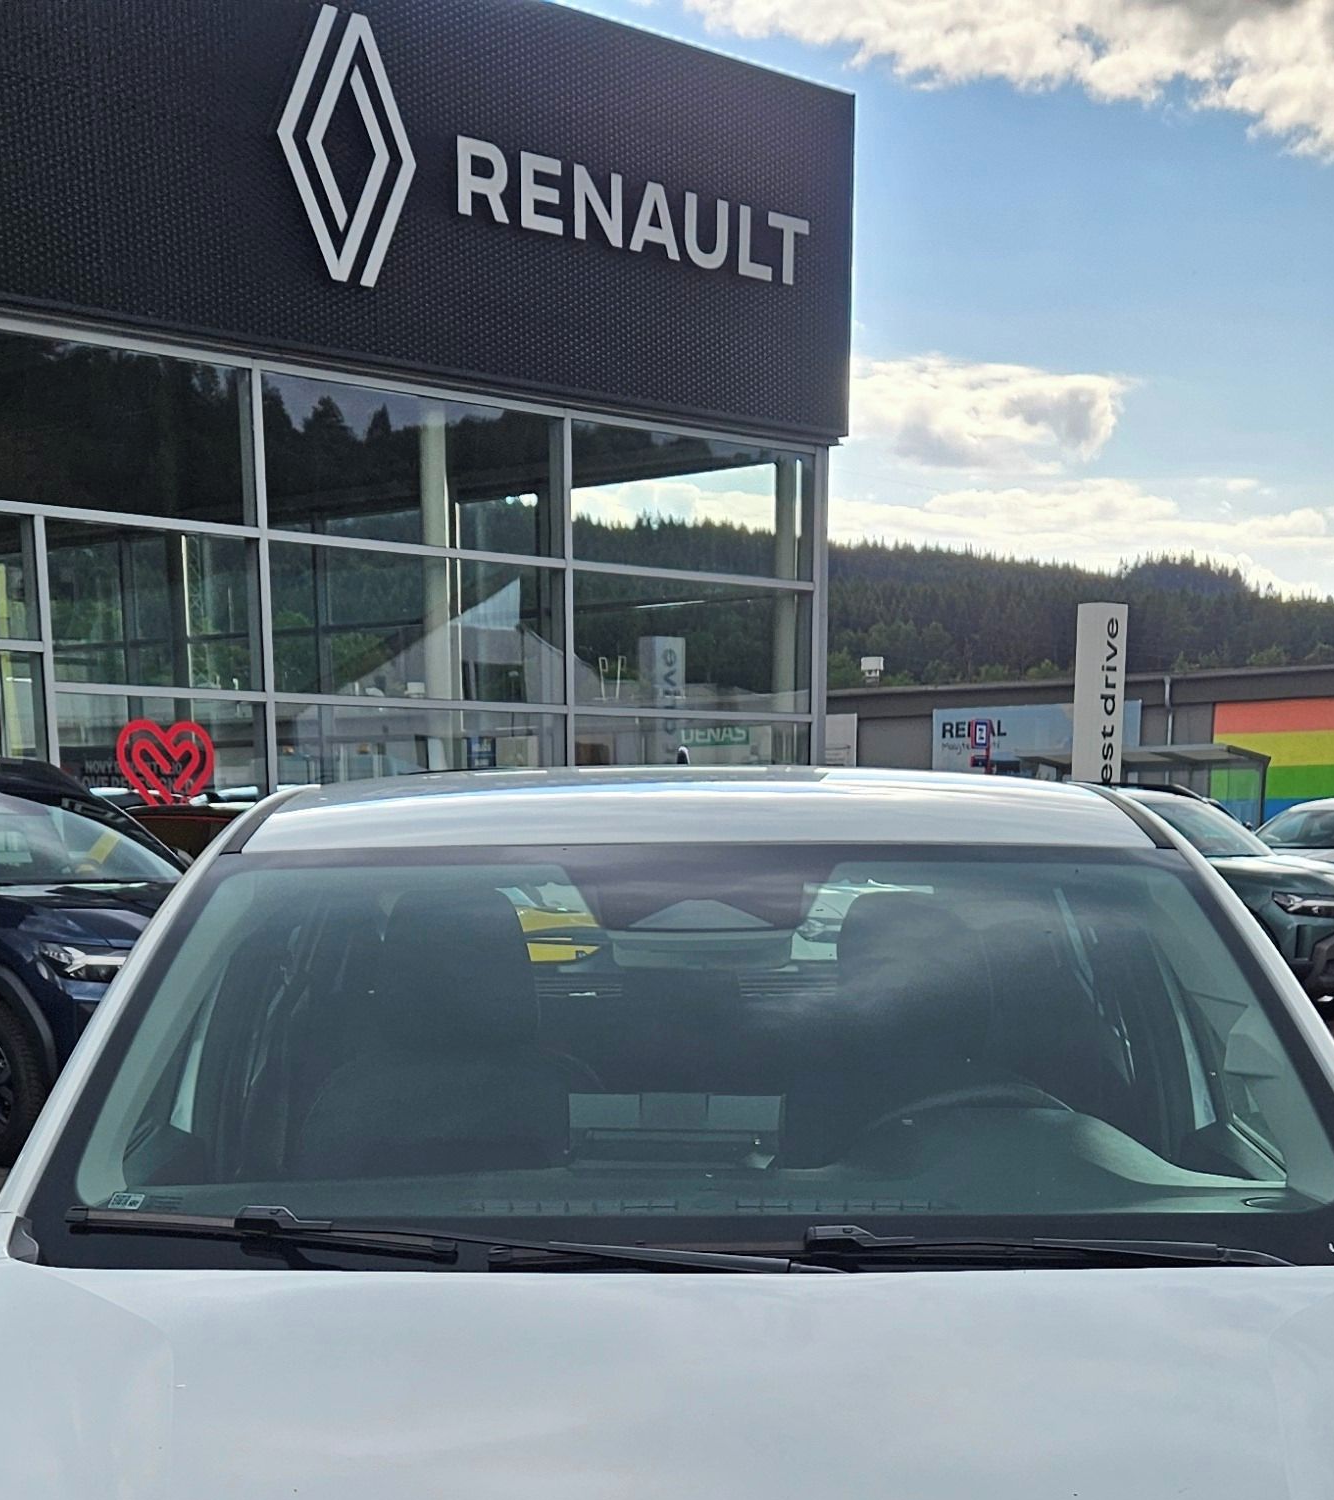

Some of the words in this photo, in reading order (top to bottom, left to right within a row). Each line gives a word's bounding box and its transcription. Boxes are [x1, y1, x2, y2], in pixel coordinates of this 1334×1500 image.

[457, 135, 810, 285] RENAULT
[1100, 617, 1119, 716] drive
[1101, 725, 1114, 784] est
